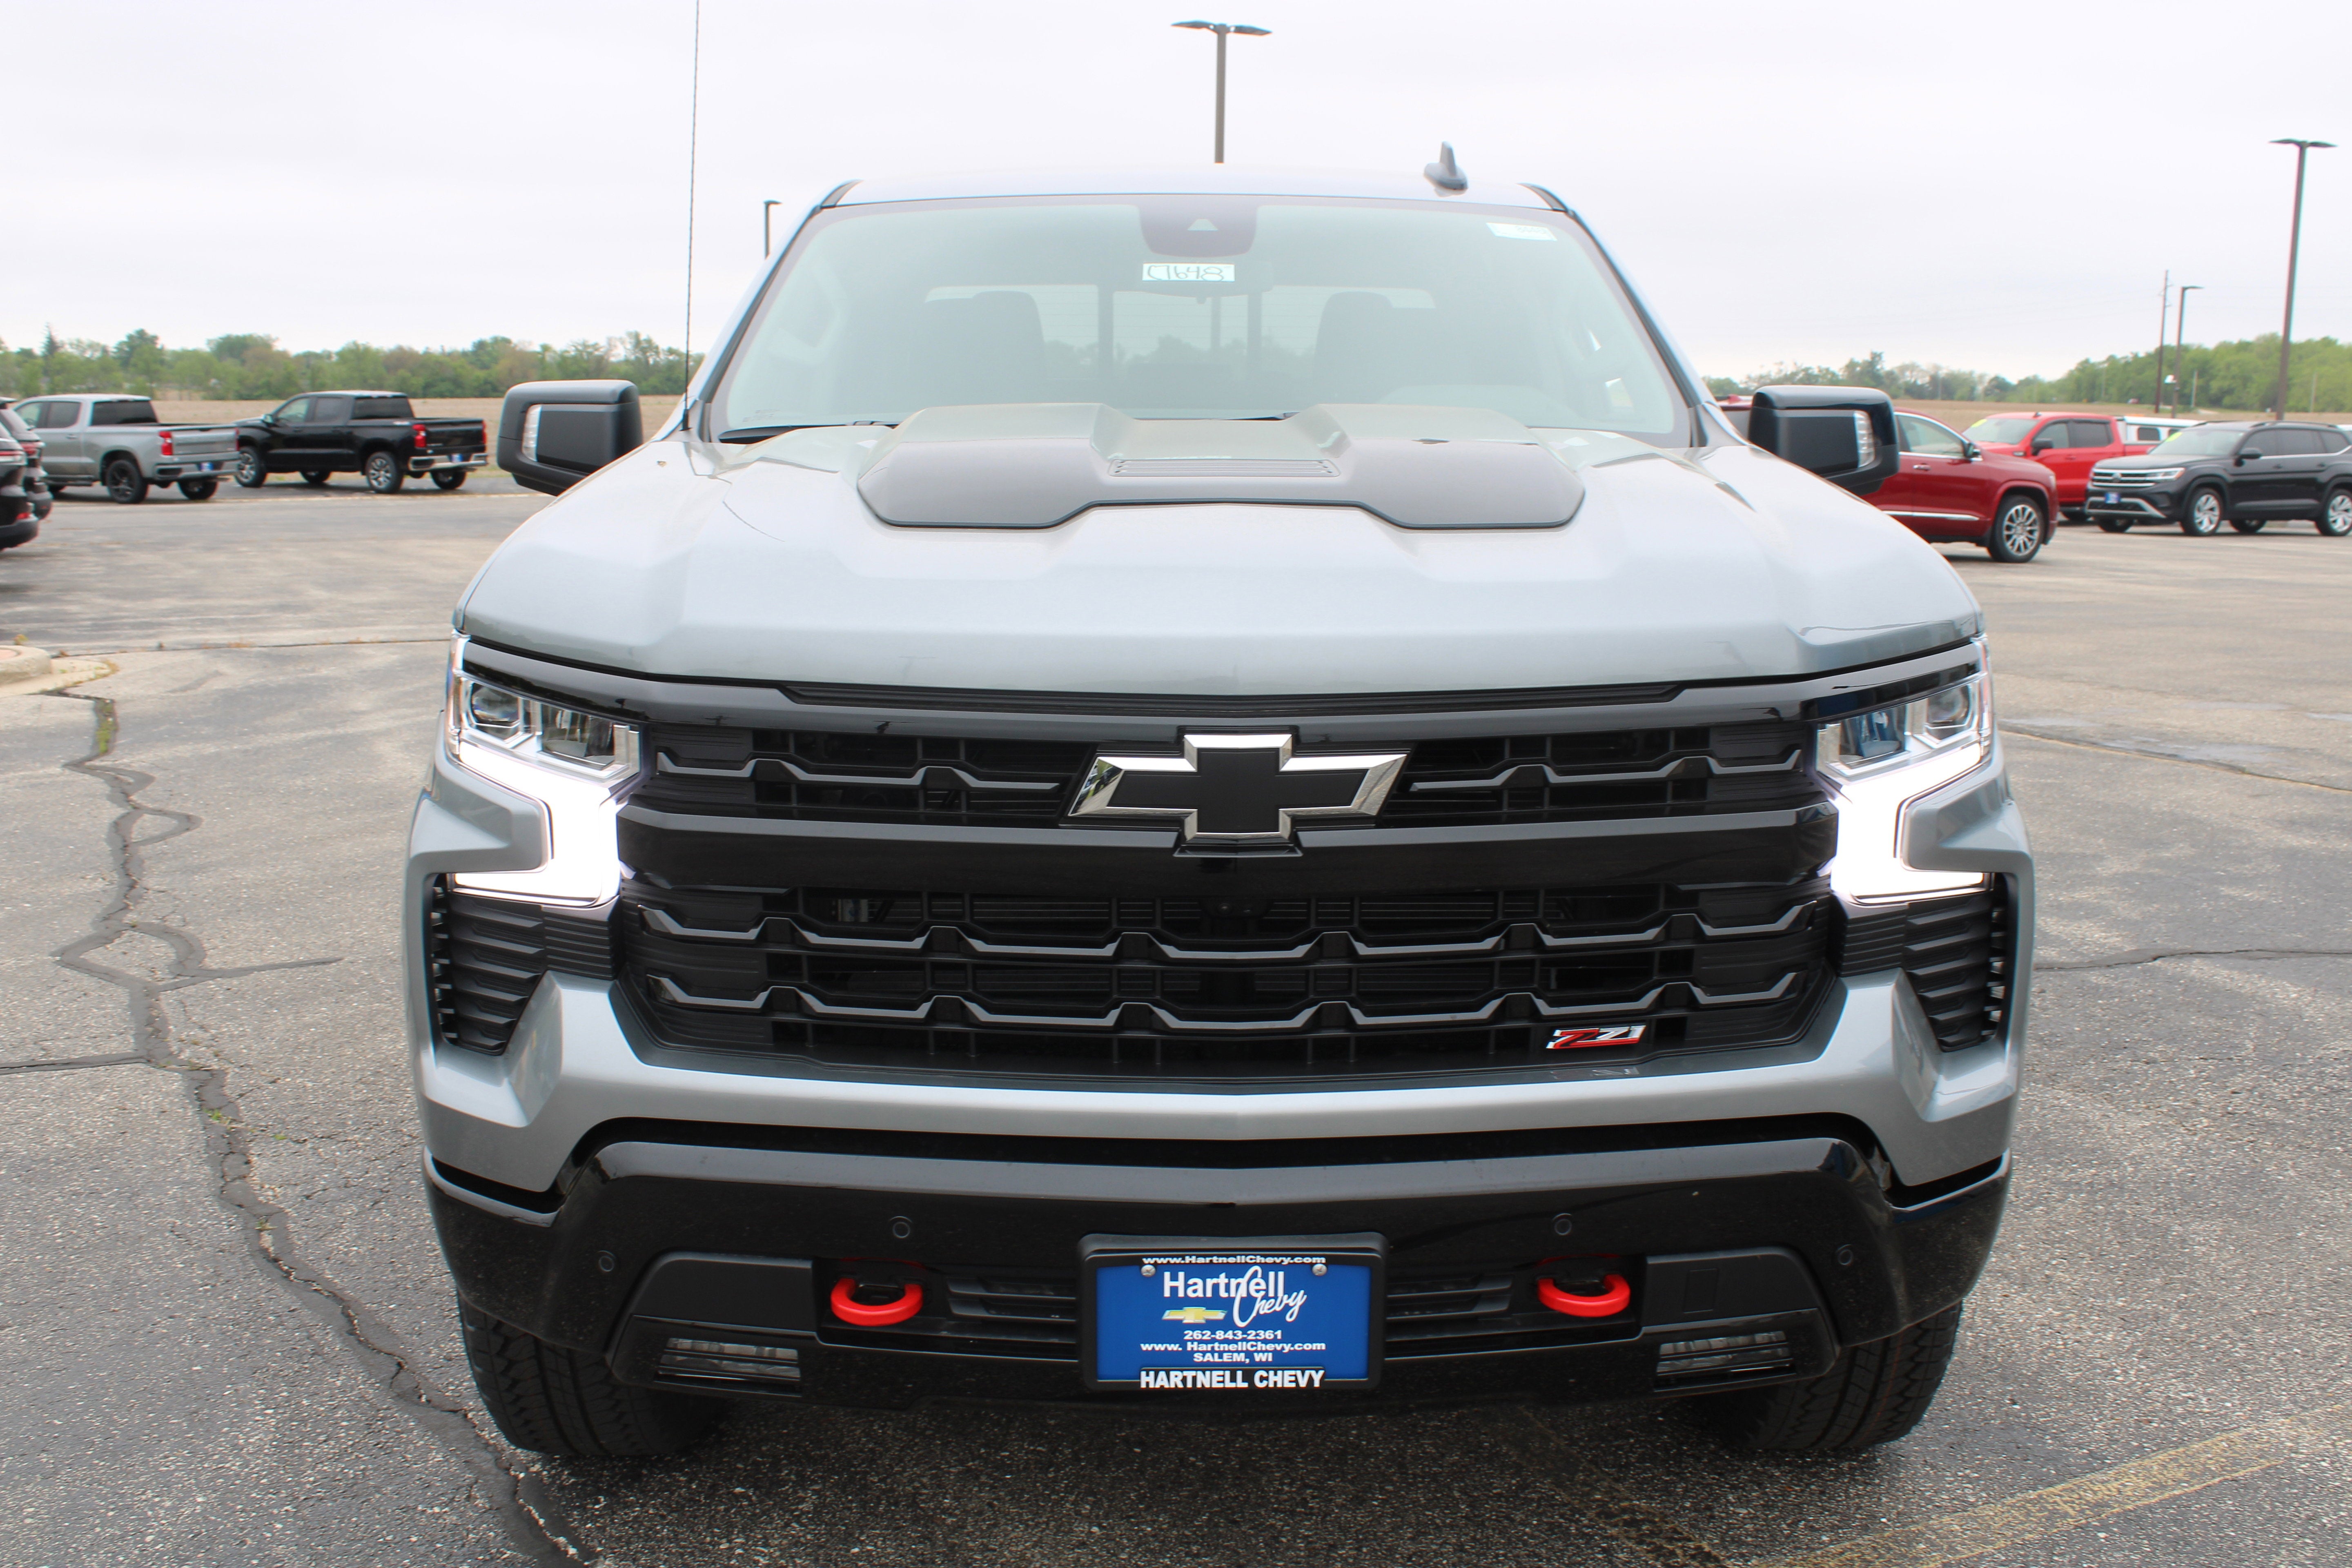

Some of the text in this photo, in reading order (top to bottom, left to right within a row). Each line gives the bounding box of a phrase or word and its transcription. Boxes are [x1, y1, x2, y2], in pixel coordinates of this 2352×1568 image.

[1143, 1255, 1326, 1265] www.HartnellChevy.com
[1163, 1271, 1285, 1298] Hartnell
[1233, 1265, 1307, 1327] Chevy
[1183, 1330, 1282, 1340] 262-843-2361
[1187, 1341, 1326, 1352] HartnellChevy.com
[1193, 1352, 1273, 1363] SALEM, WI
[1140, 1370, 1325, 1388] HARTNELL CHEVY
